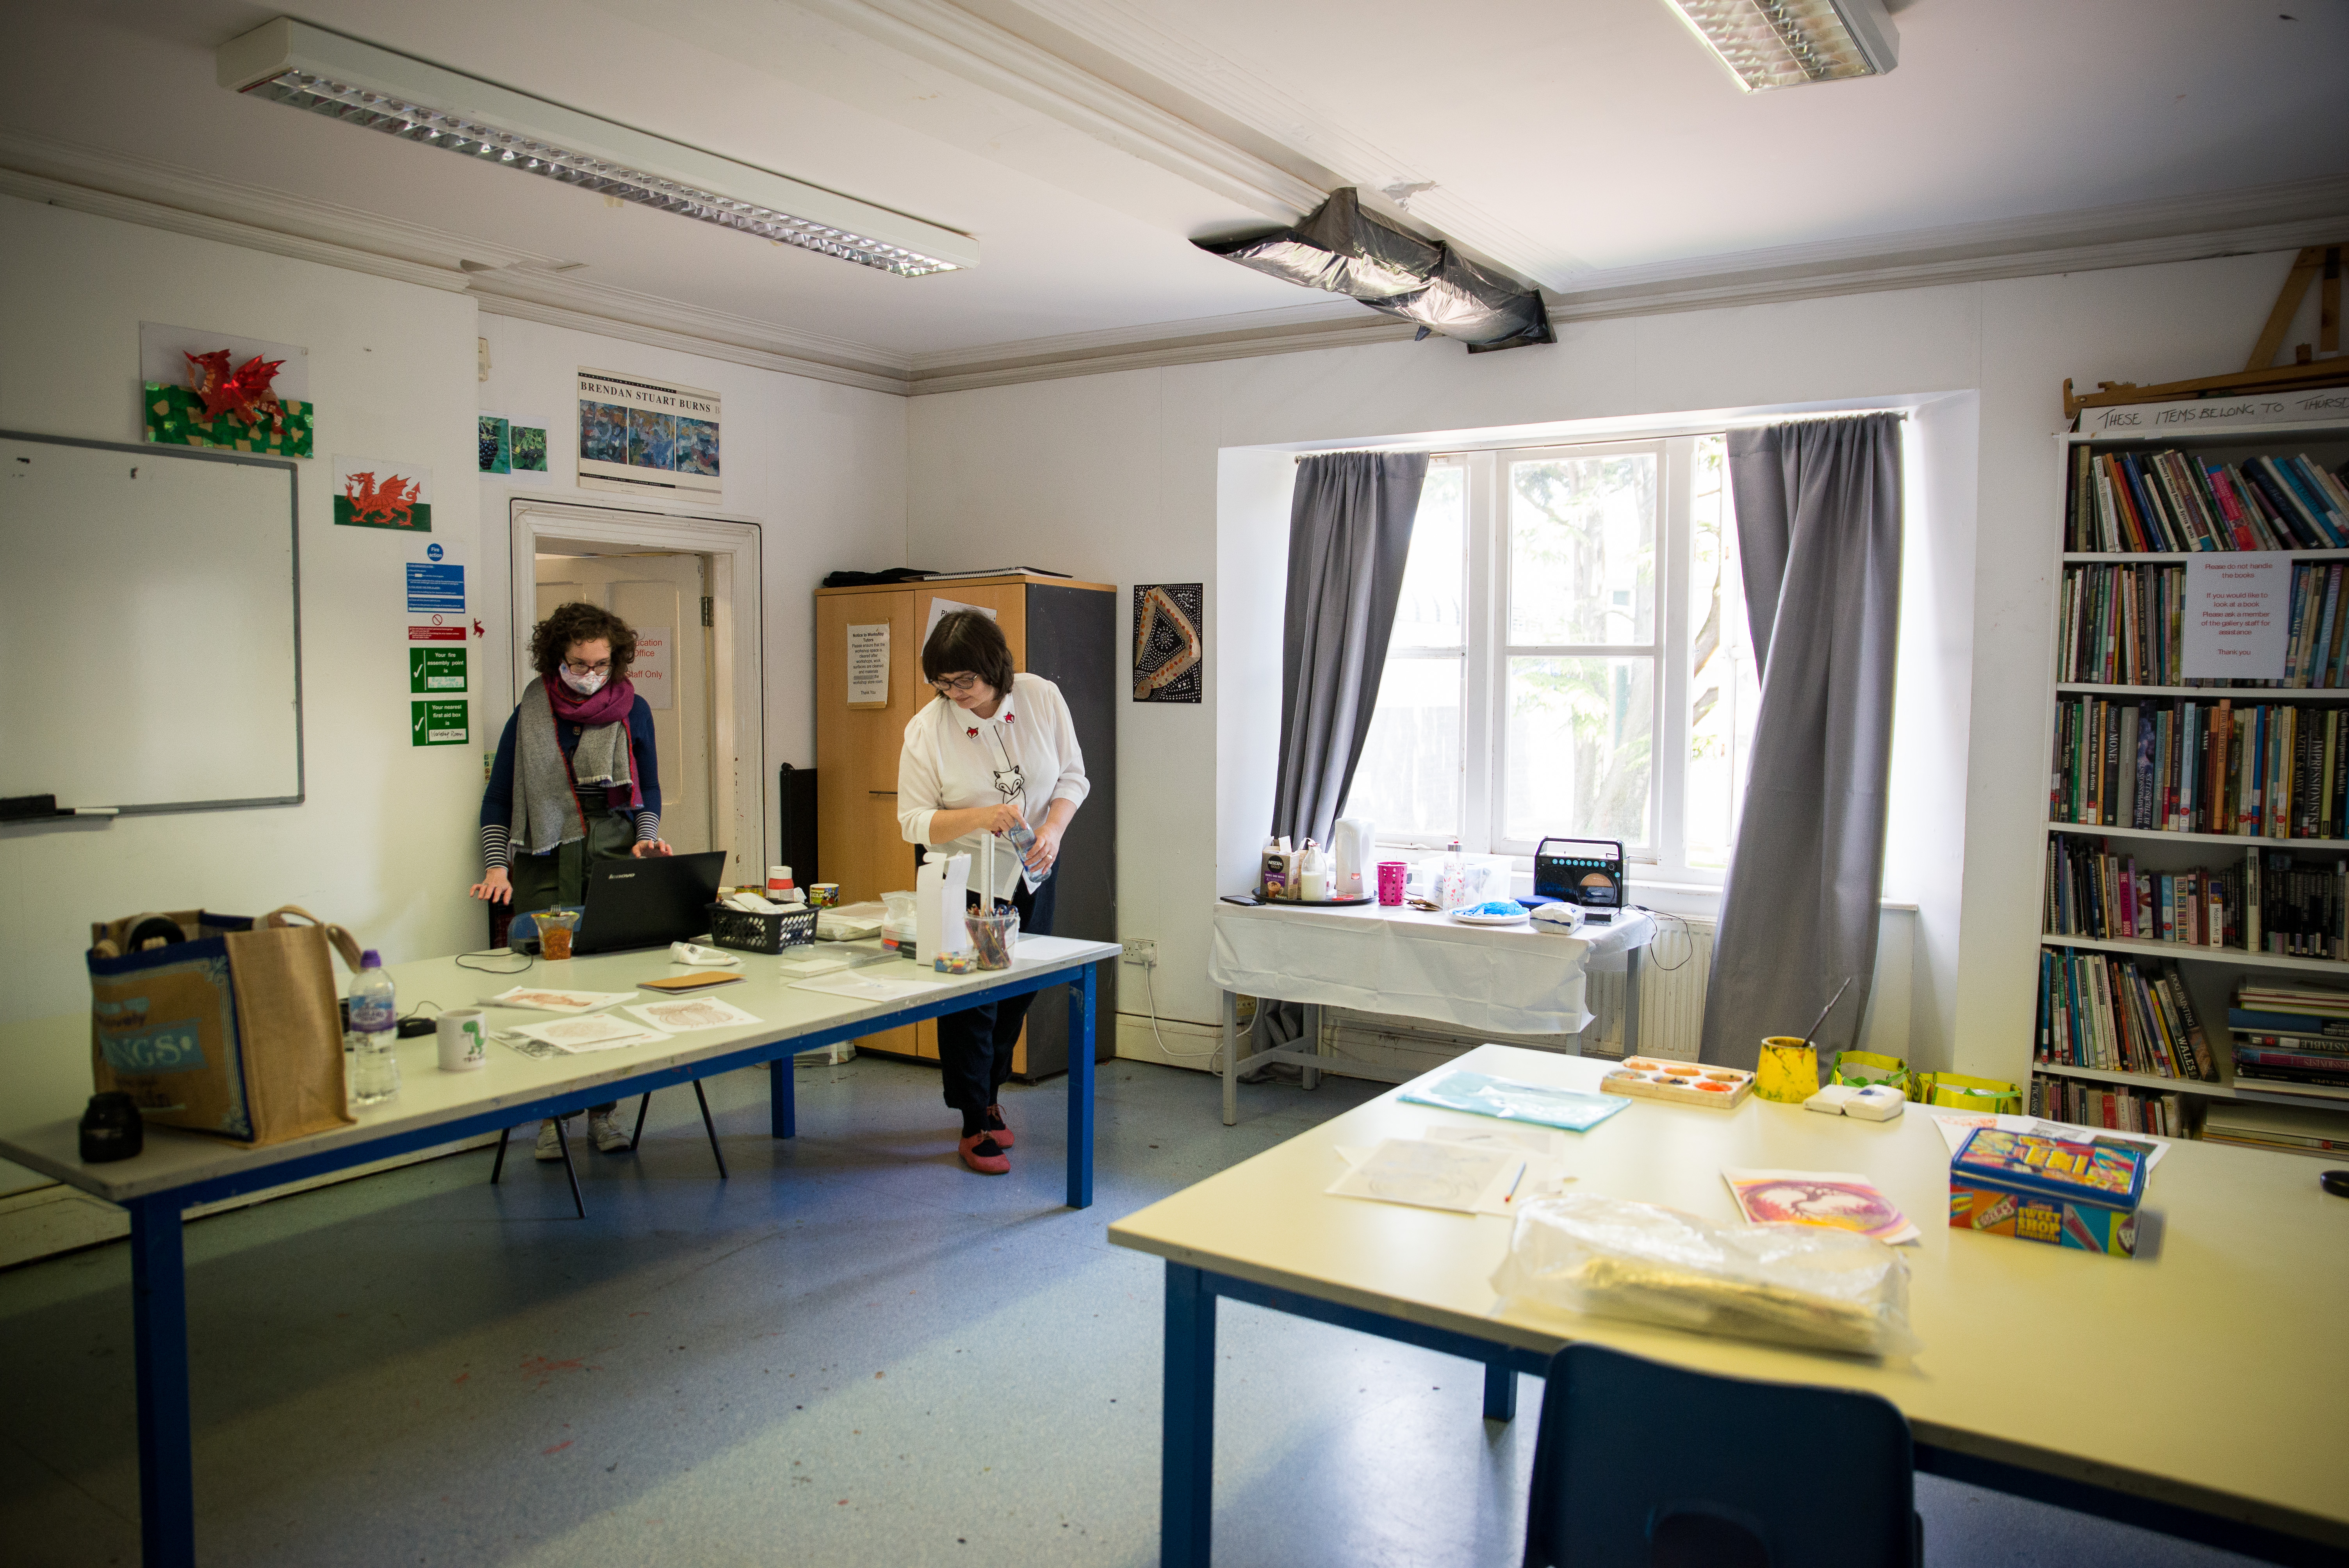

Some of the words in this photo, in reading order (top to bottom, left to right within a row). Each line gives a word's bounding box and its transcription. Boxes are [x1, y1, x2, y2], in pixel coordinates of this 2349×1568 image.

[581, 381, 632, 398] BRENDAN
[636, 391, 676, 406] STUART
[679, 399, 710, 412] BURNS
[2098, 408, 2142, 429] THESE
[2155, 407, 2196, 425] ITEMS
[2199, 404, 2255, 419] BELONG
[2260, 402, 2285, 413] TO
[2094, 458, 2104, 485] LANDSCAPE
[2099, 492, 2108, 511] BRITAIN
[2196, 456, 2210, 478] Handmade
[2206, 478, 2215, 492] Books
[2157, 457, 2170, 478] Jewellery
[2165, 478, 2177, 494] Making
[2173, 493, 2183, 510] Manual
[2179, 510, 2190, 524] Sylvia
[2185, 524, 2196, 539] Wicks
[2178, 478, 2189, 495] DRAWING
[2186, 499, 2200, 524] ILLUSTRATION
[2228, 497, 2240, 517] ORIGAMI
[2320, 567, 2341, 644] IMPRESSIONISM
[645, 670, 663, 680] Only
[2110, 707, 2118, 731] Essential
[2108, 733, 2118, 764] MONET
[2297, 734, 2306, 759] AZTEC
[2137, 764, 2145, 813] IMPRESSIONISTS
[2295, 770, 2304, 792] MAYA
[2309, 741, 2323, 824] IMPRESSIONISTS
[2338, 768, 2347, 783] World
[2144, 816, 2149, 825] BY
[2121, 883, 2130, 921] CERAMICS
[2159, 982, 2170, 1000] Wynford
[2171, 974, 2182, 990] DOG
[2178, 992, 2195, 1026] PAINTING
[2084, 998, 2092, 1035] IMPRESSIONISM
[2178, 1036, 2196, 1073] WALES
[2300, 1039, 2349, 1051] NSTABLE
[2018, 1206, 2062, 1223] SWEET
[2018, 1217, 2061, 1235] SHOP
